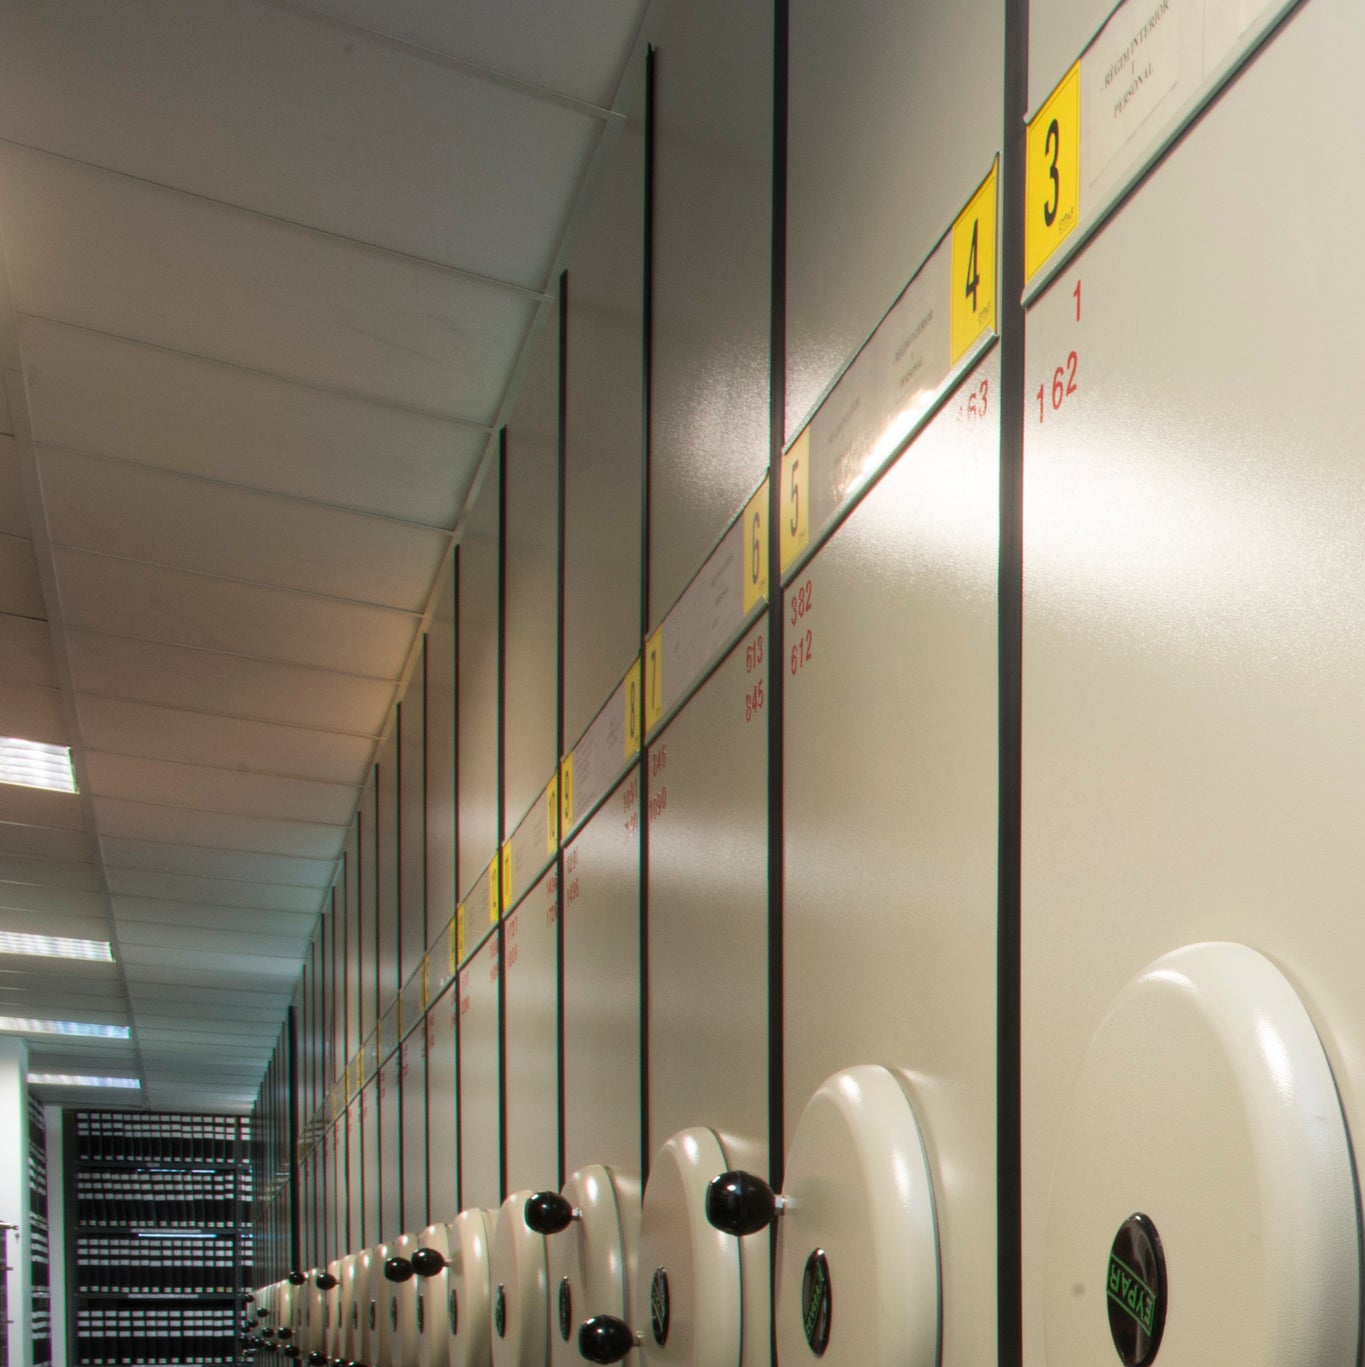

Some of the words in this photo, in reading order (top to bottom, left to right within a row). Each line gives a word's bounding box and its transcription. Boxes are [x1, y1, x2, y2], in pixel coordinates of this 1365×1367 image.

[1044, 118, 1059, 228] 3
[965, 218, 980, 313] 4
[1073, 279, 1081, 323] 1
[1037, 350, 1078, 424] 162
[788, 458, 800, 537] 5
[752, 511, 760, 585] 6
[791, 579, 812, 627] 382
[651, 650, 656, 711] 7
[746, 635, 763, 673] 613
[791, 629, 812, 676] 612
[745, 679, 764, 723] 845
[1109, 1263, 1152, 1327] EYPAR
